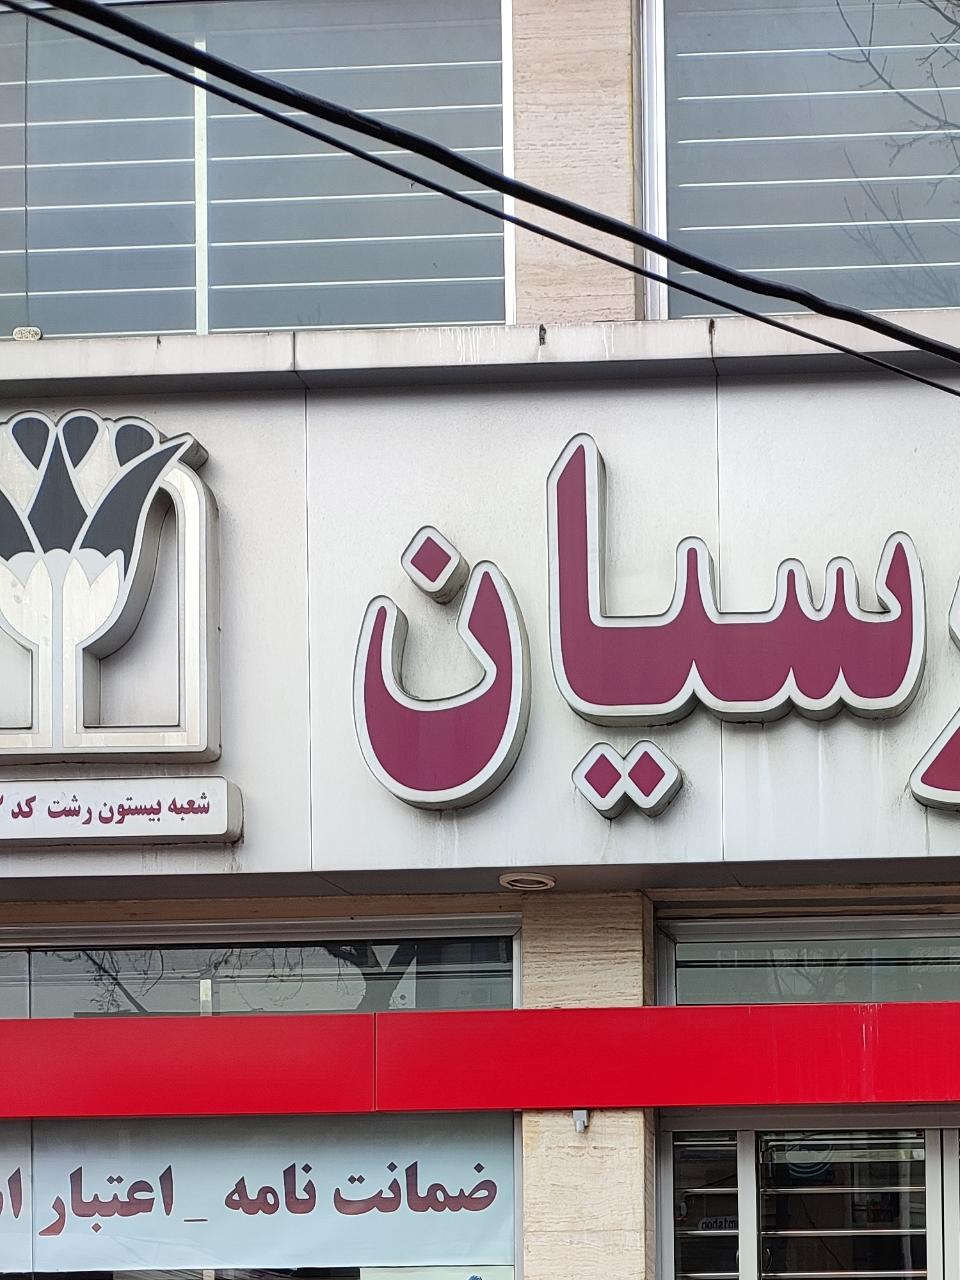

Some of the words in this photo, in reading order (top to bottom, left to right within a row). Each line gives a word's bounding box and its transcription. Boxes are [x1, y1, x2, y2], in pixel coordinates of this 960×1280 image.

[11, 795, 37, 819] کد
[47, 794, 93, 825] رشت
[98, 796, 162, 825] بیستون
[168, 792, 210, 821] شعبه
[38, 1163, 174, 1237] اعتبار
[224, 1161, 318, 1216] نامه
[333, 1160, 498, 1216] ضمانت
